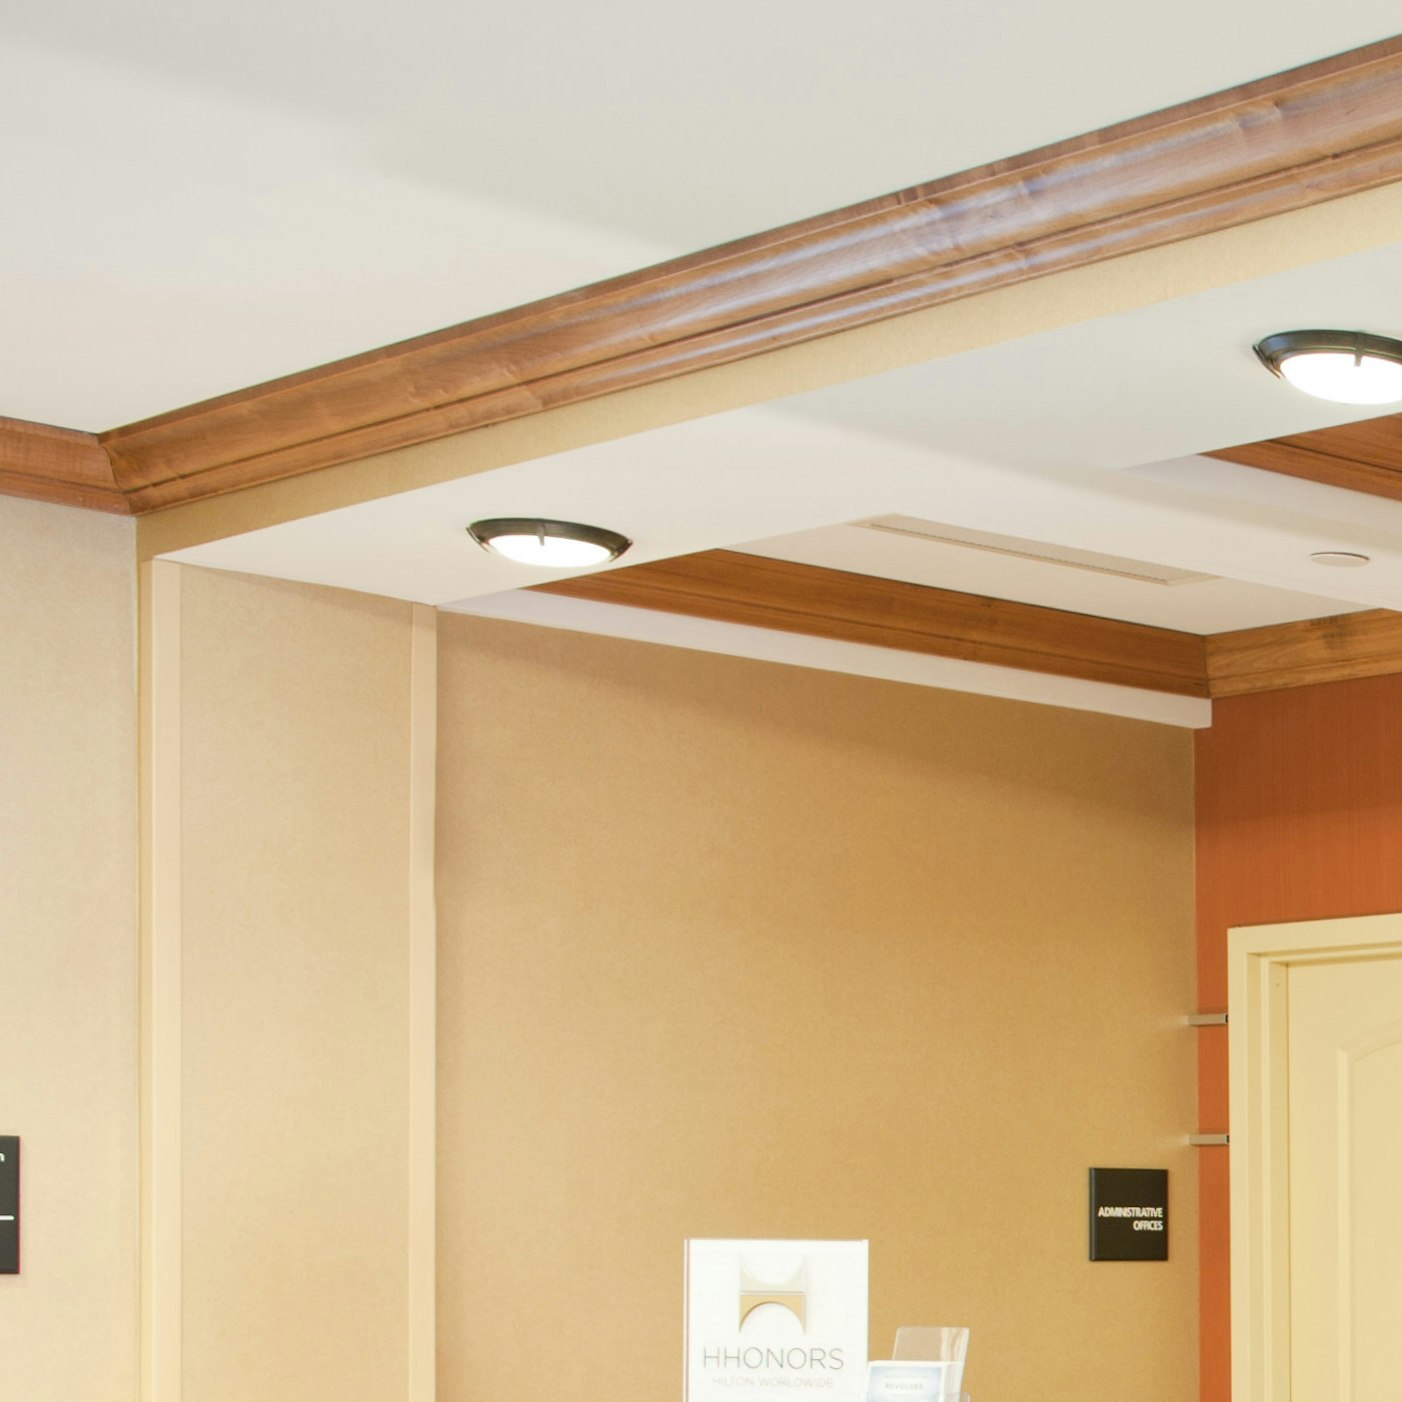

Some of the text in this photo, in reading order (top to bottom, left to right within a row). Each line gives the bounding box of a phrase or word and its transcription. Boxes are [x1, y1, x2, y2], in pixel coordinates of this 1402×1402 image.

[1098, 1206, 1163, 1217] ADMINISTRATIVE
[1133, 1220, 1163, 1230] OFFICES
[703, 1346, 844, 1370] HHONORS
[712, 1376, 834, 1389] HILTON WORLDWIDE
